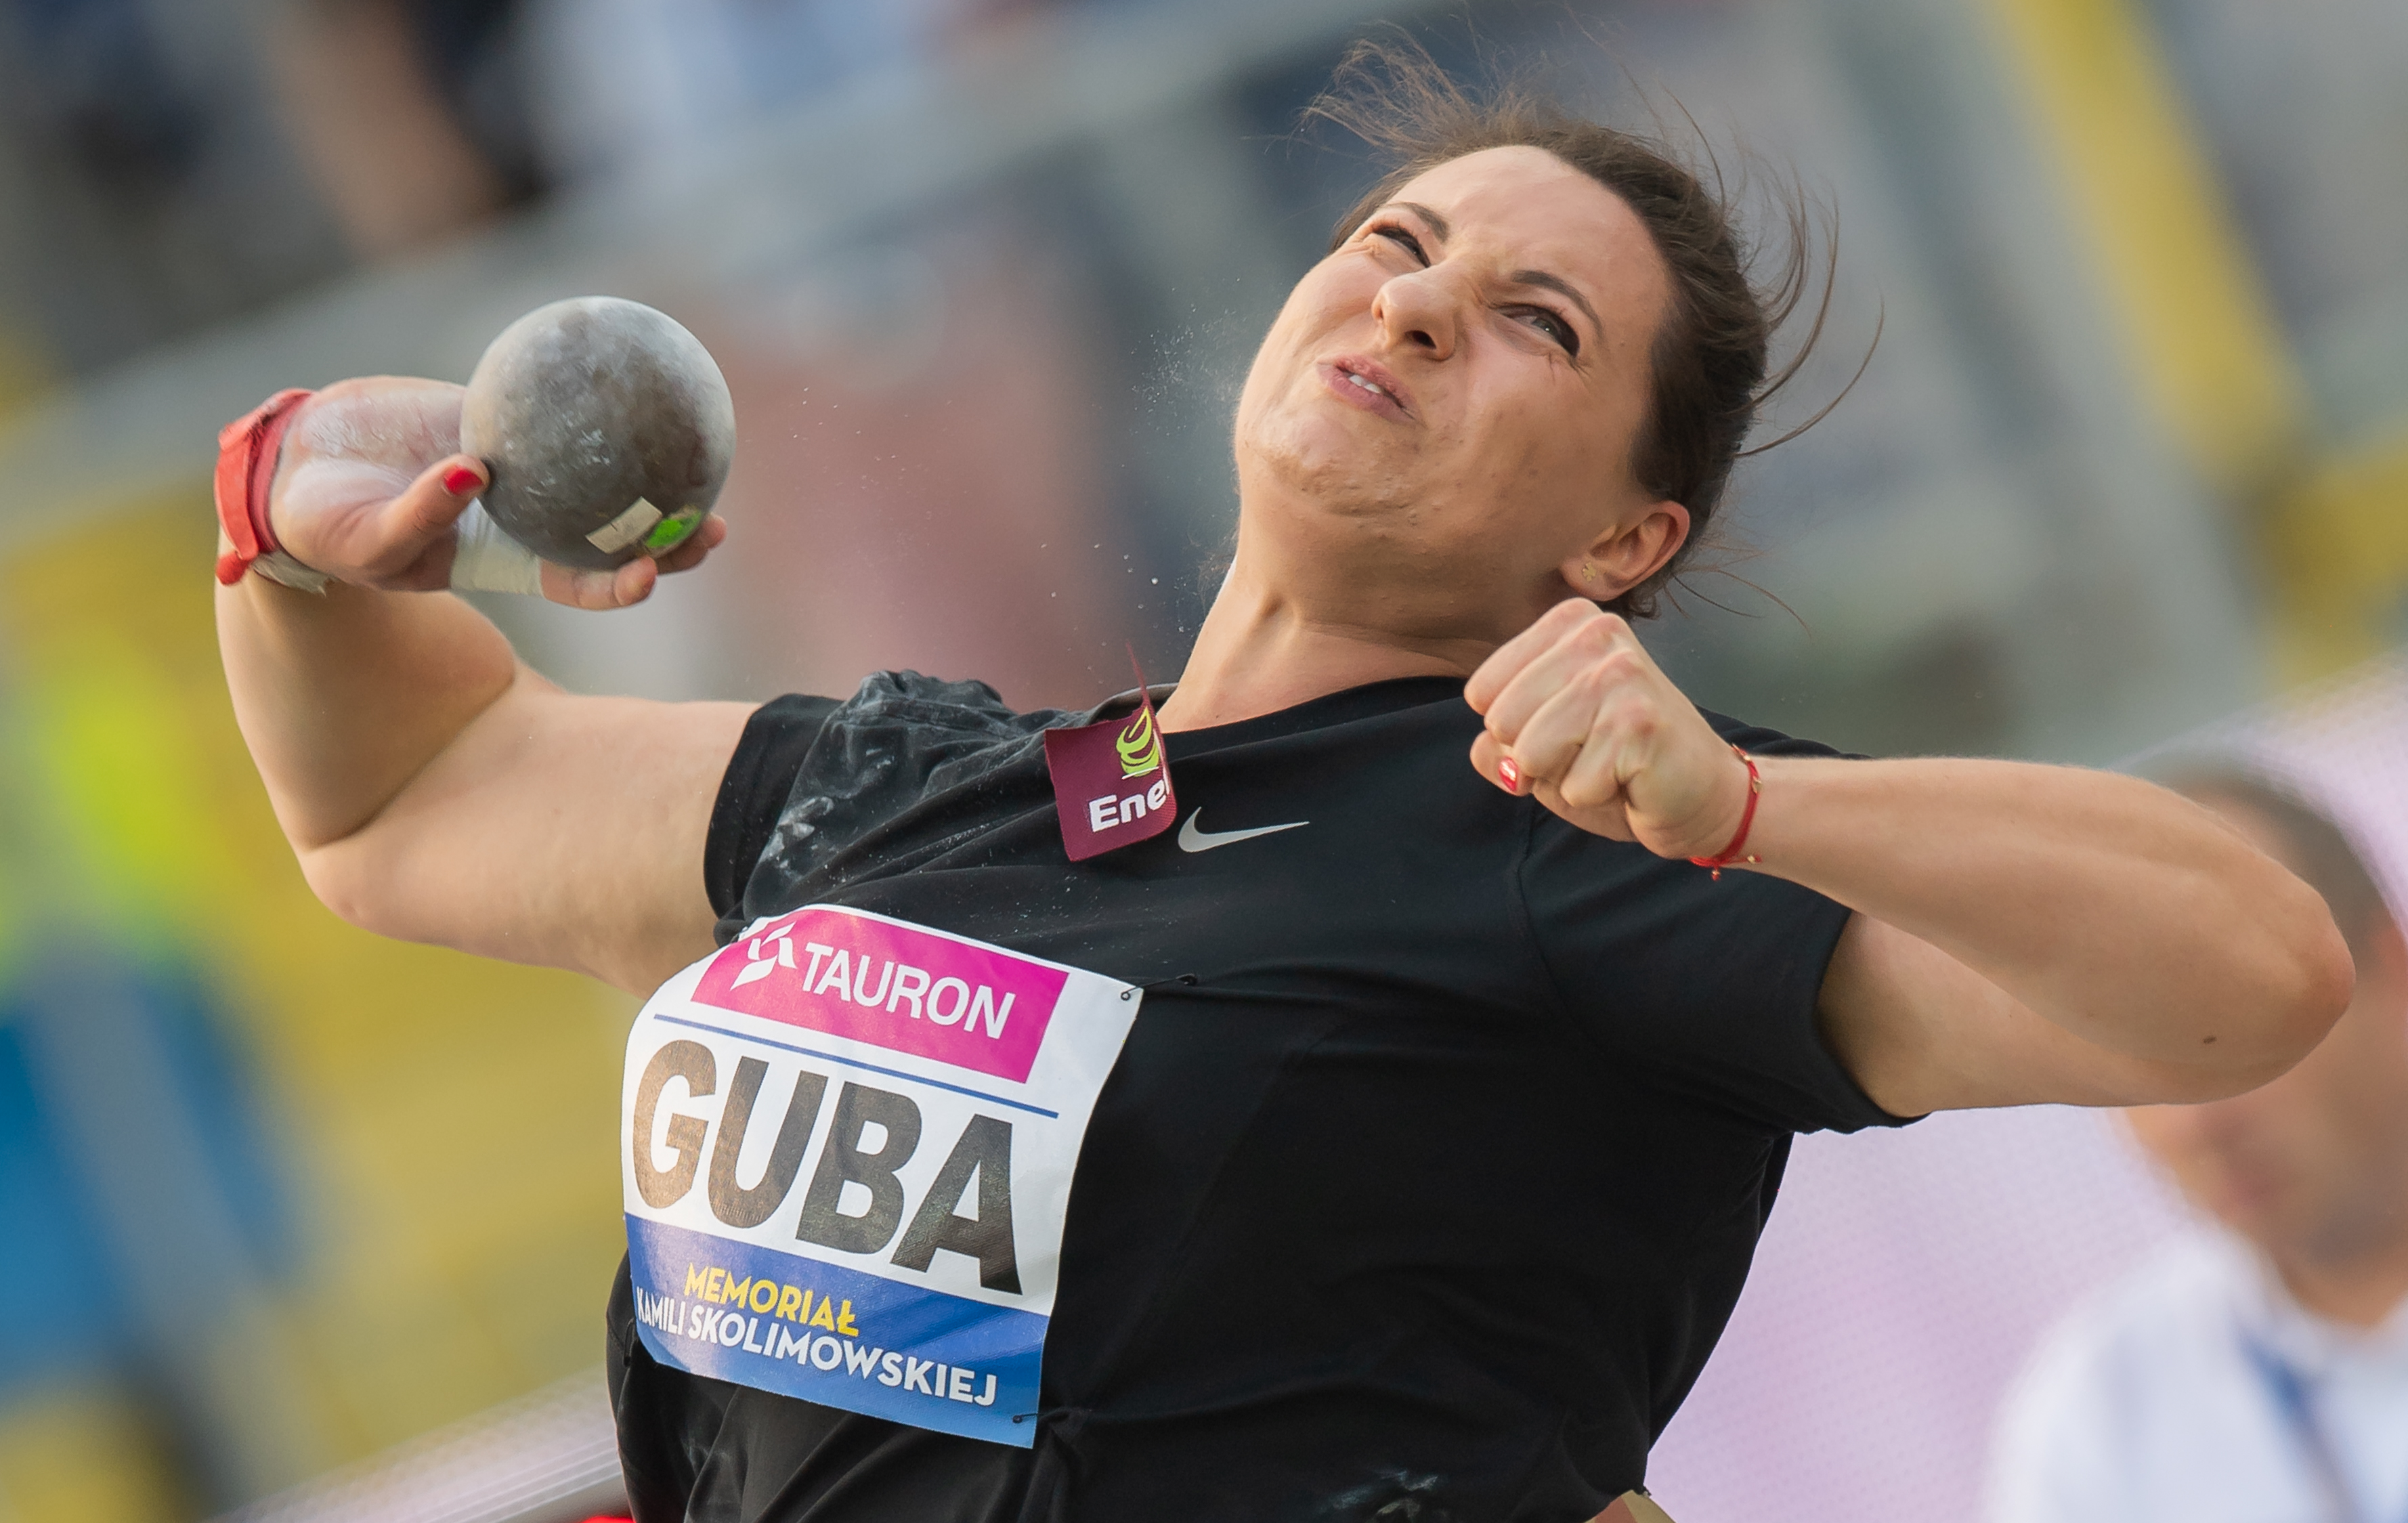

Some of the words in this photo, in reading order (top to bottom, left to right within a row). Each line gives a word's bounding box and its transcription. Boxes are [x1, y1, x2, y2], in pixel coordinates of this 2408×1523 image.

[802, 943, 1016, 1039] TAURON
[632, 1039, 1023, 1295] GUBA
[637, 1286, 686, 1335] KAMILI
[687, 1304, 997, 1407] SKOLIMOWSKIEJ
[684, 1263, 859, 1336] MEMORIAŁ
